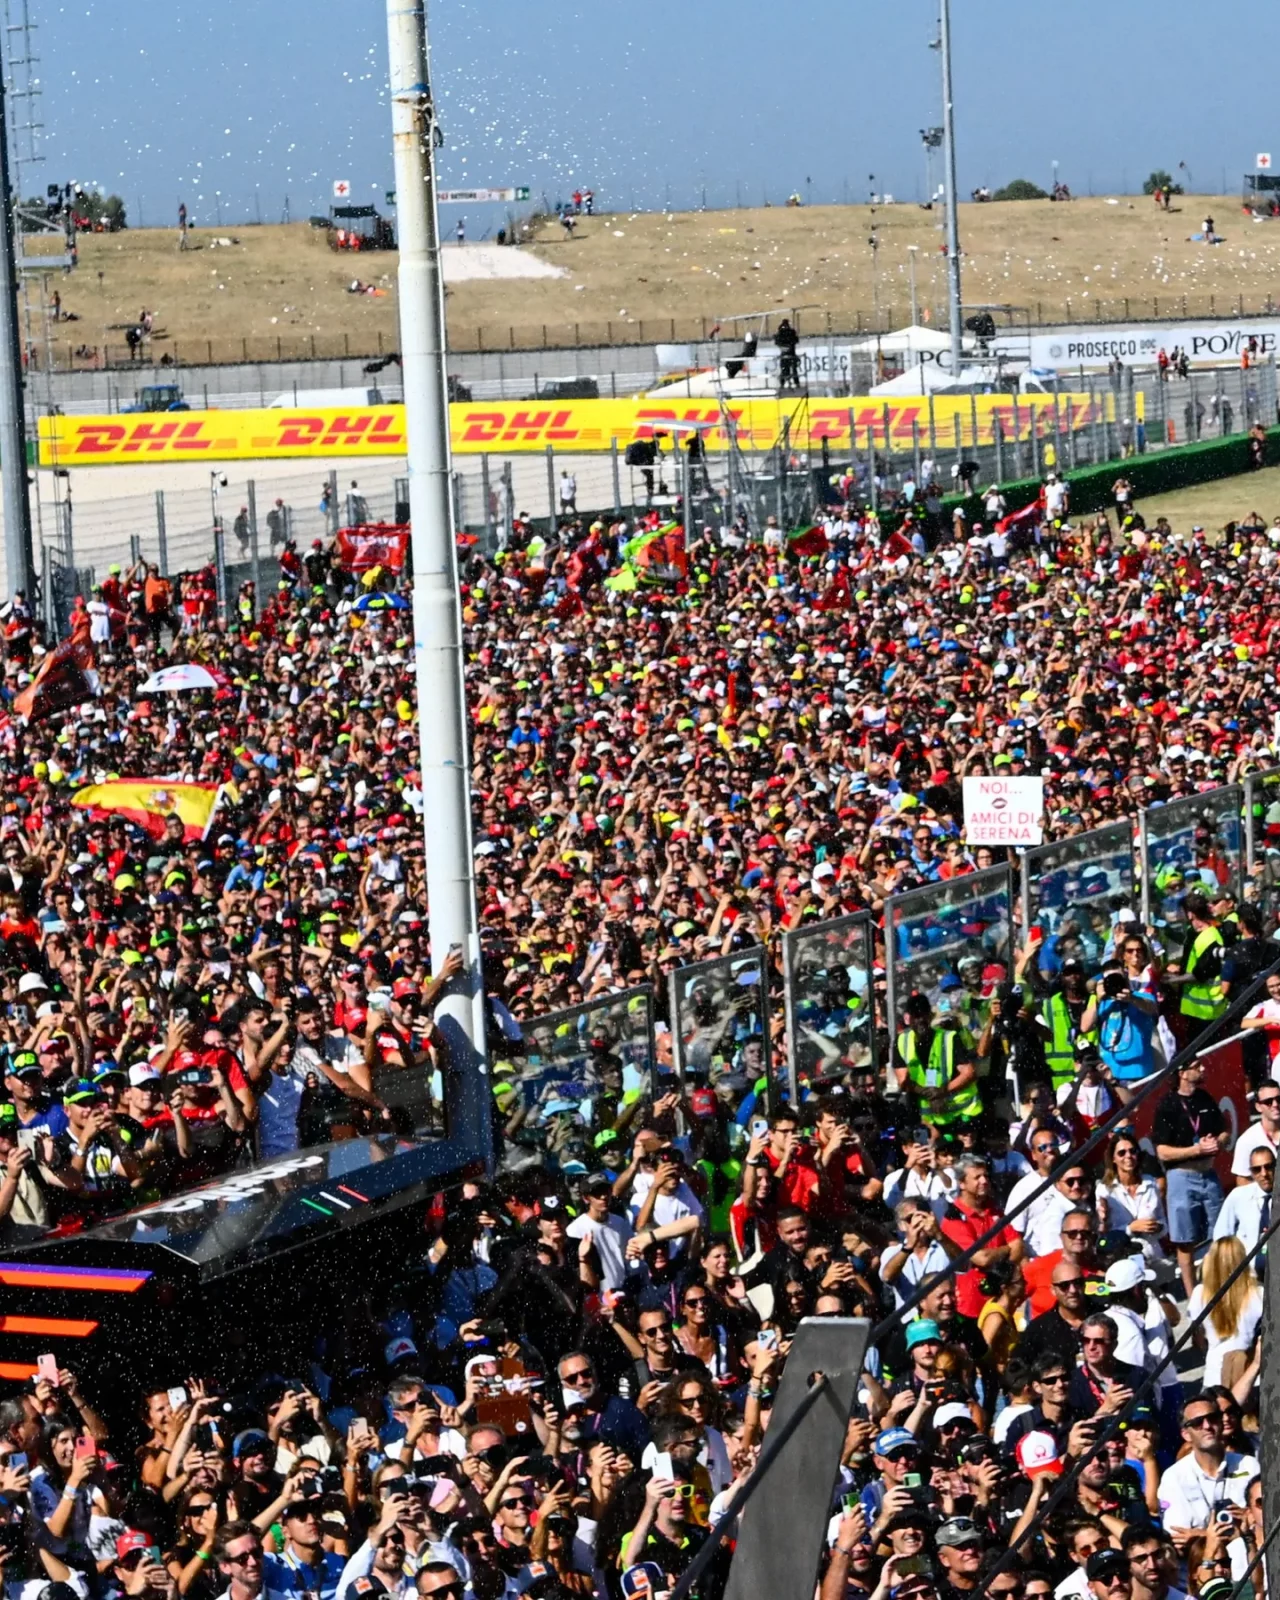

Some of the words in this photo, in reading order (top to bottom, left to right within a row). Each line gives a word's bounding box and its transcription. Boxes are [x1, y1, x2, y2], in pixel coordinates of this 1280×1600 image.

[1068, 339, 1136, 358] PROSECCO
[75, 420, 212, 454] DHL
[276, 415, 401, 447] DHL
[462, 410, 579, 442] DHL
[809, 406, 928, 438] DHL
[970, 812, 1012, 825] AMICI
[1018, 812, 1034, 825] DI
[974, 827, 1031, 840] SERENA
